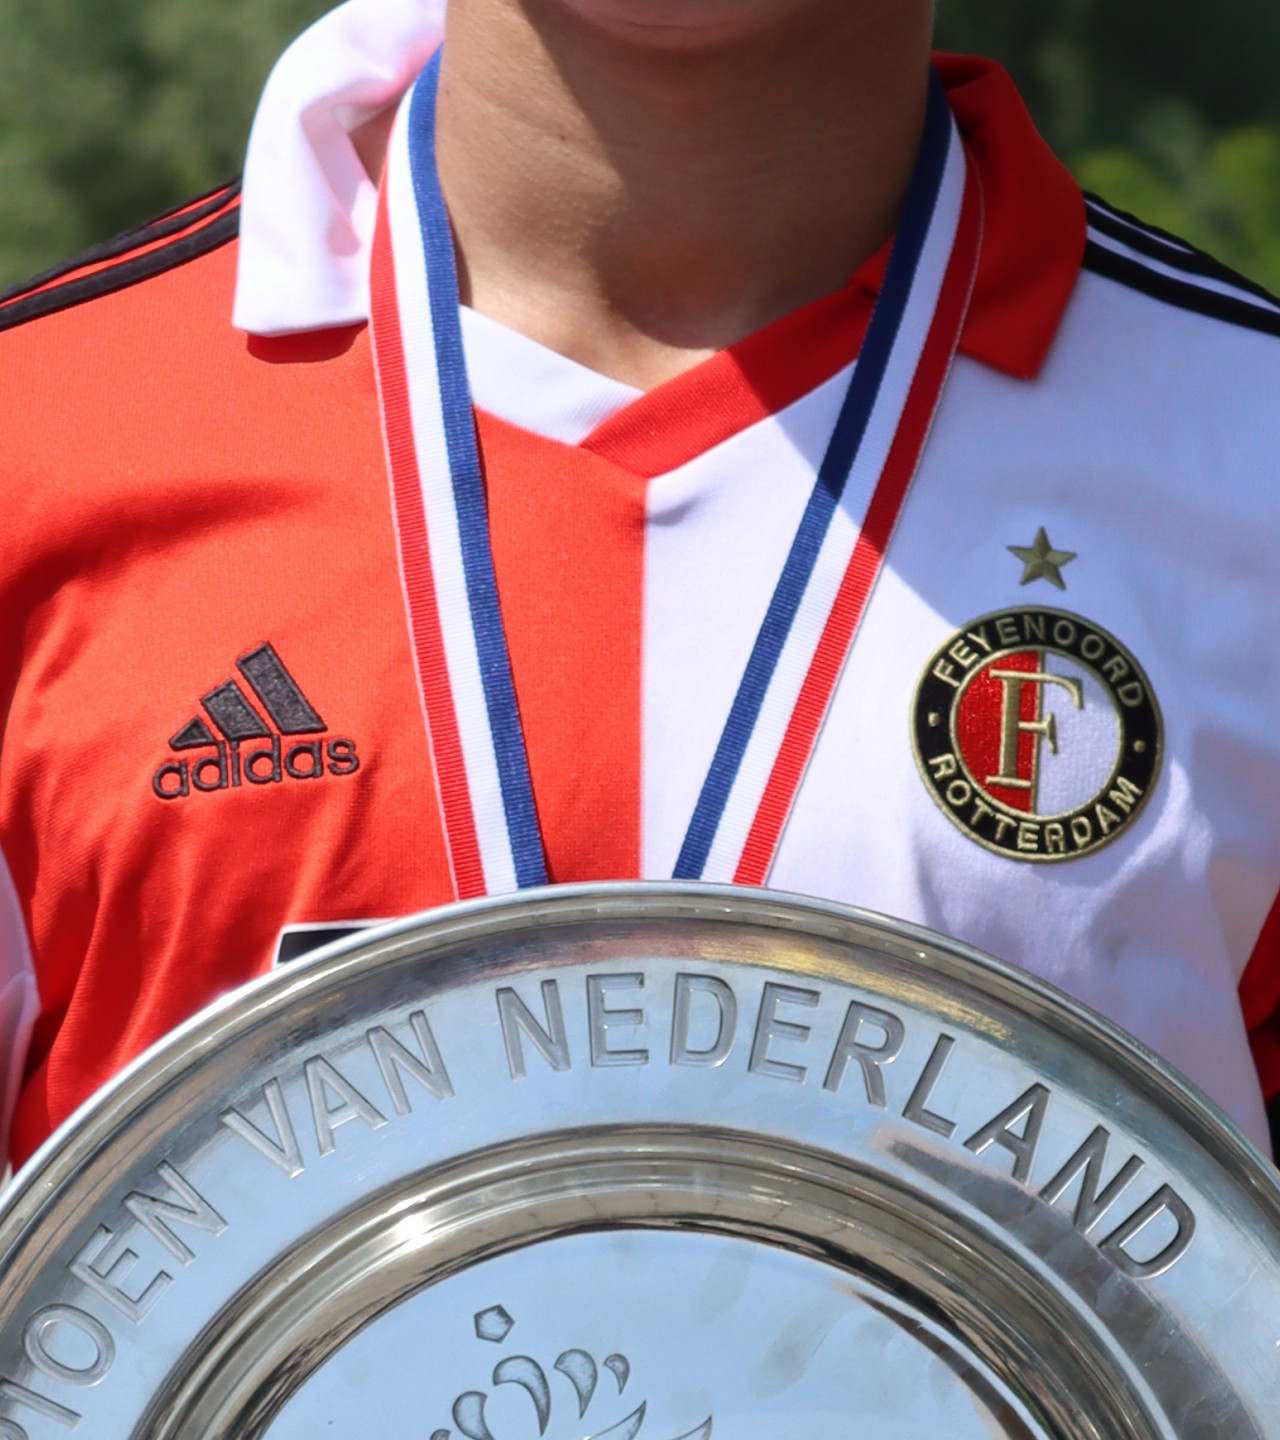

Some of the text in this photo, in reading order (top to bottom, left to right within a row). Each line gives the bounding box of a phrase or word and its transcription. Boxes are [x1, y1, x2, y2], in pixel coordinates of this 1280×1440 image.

[933, 614, 1144, 708] FEYENOORD
[152, 734, 360, 800] adidas
[985, 668, 1084, 790] F
[928, 753, 1142, 853] ROTTERDAM
[220, 1009, 455, 1178] VAN
[495, 972, 1197, 1280] NEDERLAND
